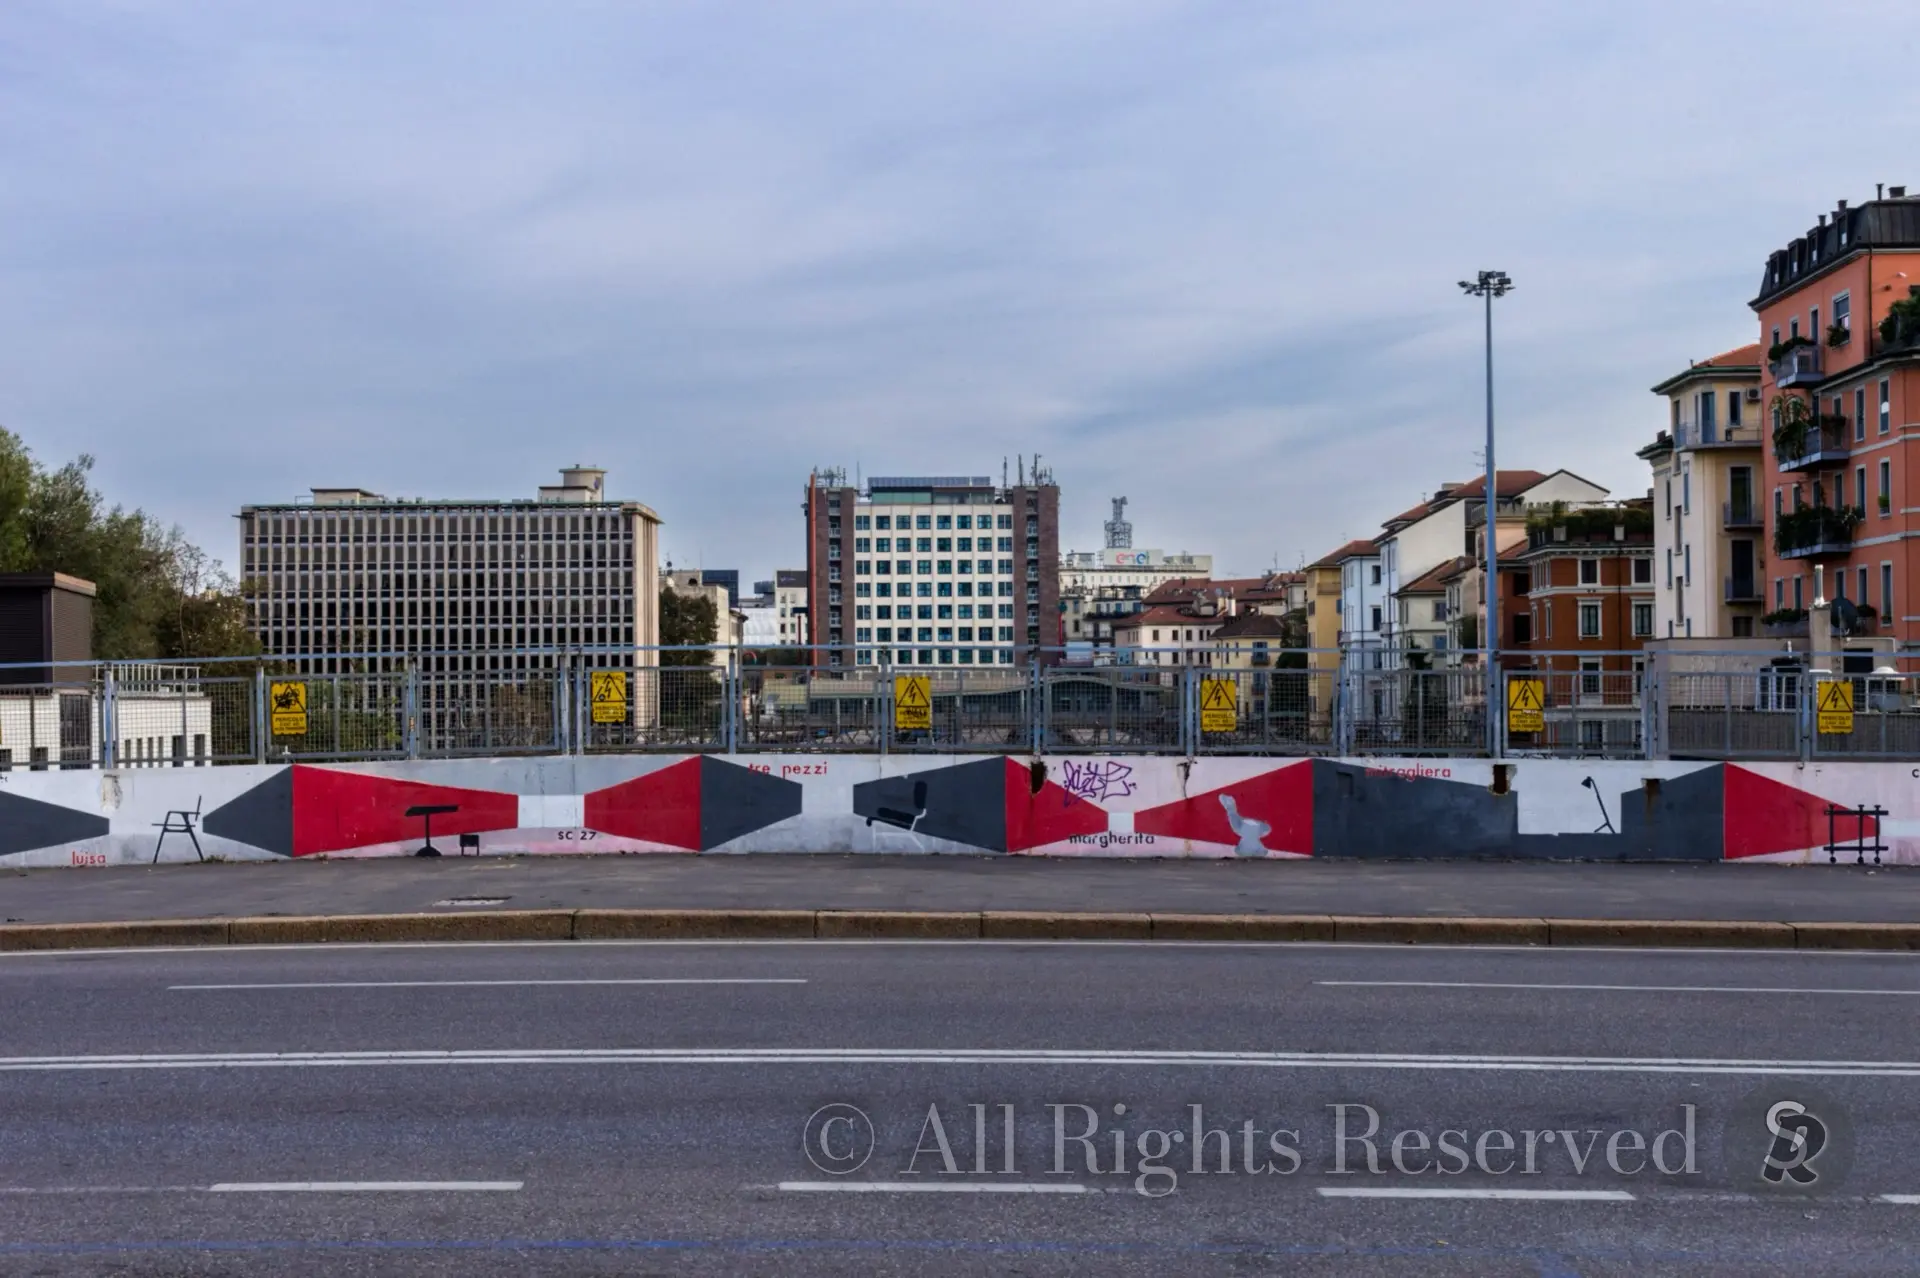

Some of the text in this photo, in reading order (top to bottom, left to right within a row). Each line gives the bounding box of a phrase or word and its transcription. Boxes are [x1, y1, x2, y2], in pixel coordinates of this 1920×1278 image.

[748, 761, 828, 780] tre pezzi
[1365, 763, 1451, 782] mitragliera
[558, 831, 597, 840] SC 27
[1069, 831, 1155, 848] margherita
[72, 851, 106, 866] luisa
